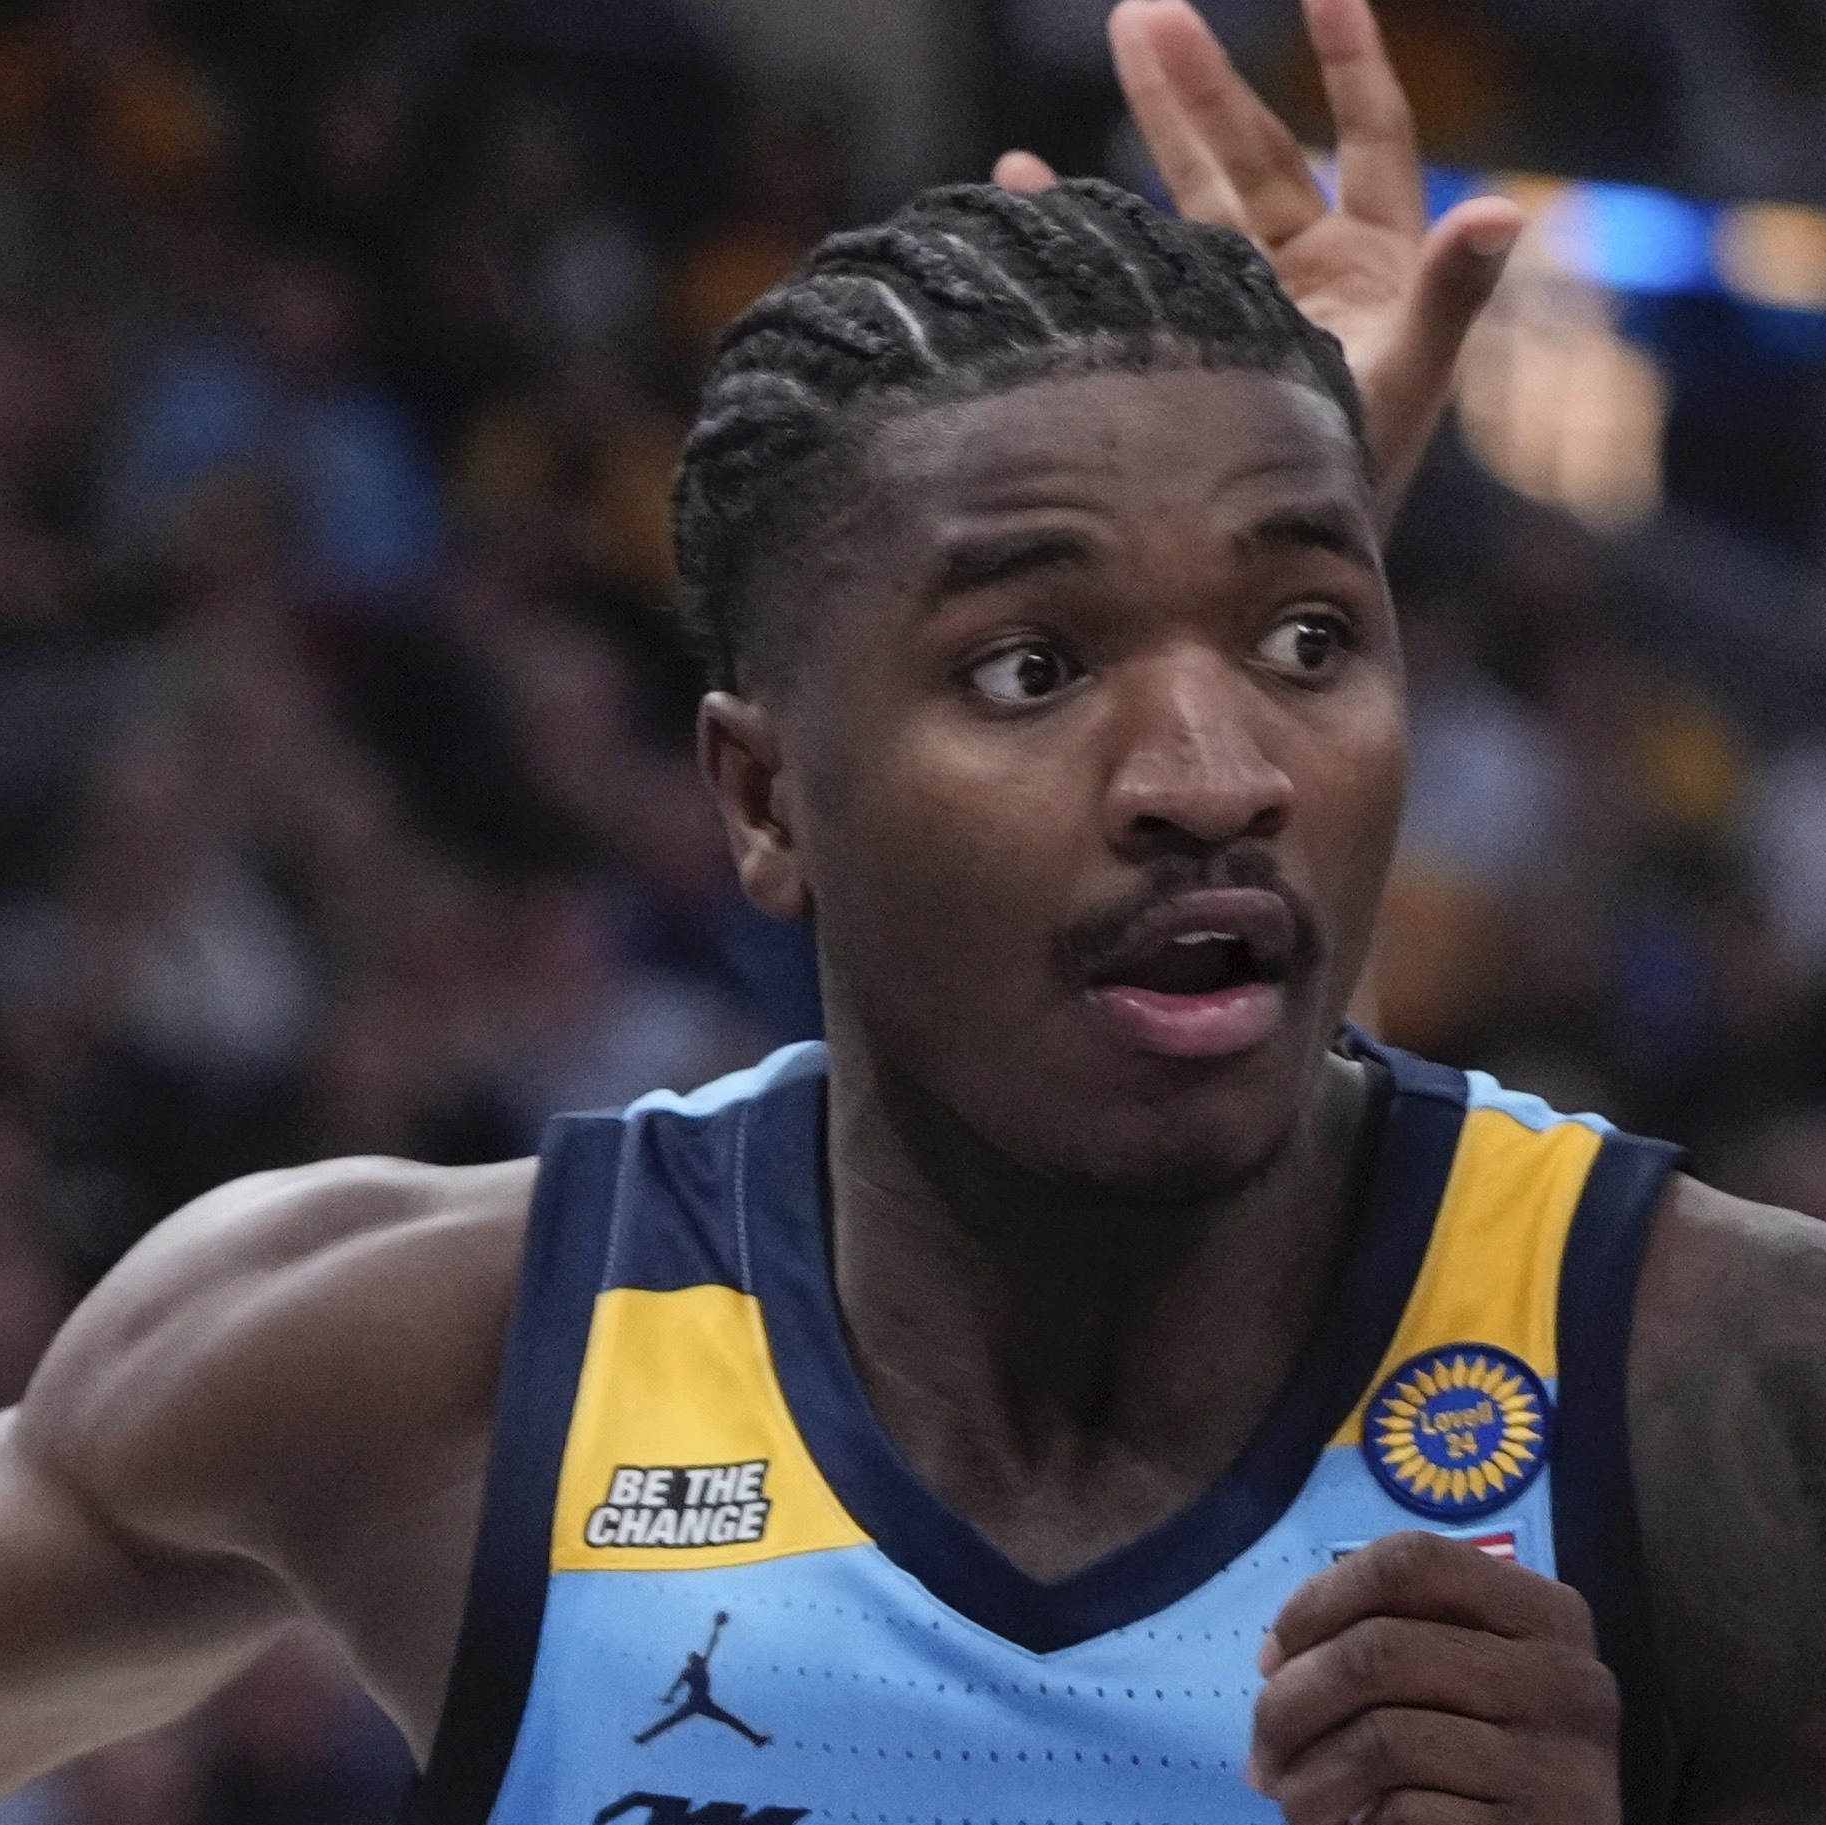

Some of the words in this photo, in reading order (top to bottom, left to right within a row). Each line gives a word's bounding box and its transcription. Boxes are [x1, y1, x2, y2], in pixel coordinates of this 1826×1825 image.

[607, 1468, 674, 1507] BE
[683, 1462, 766, 1507] THE
[586, 1501, 769, 1546] CHANGE
